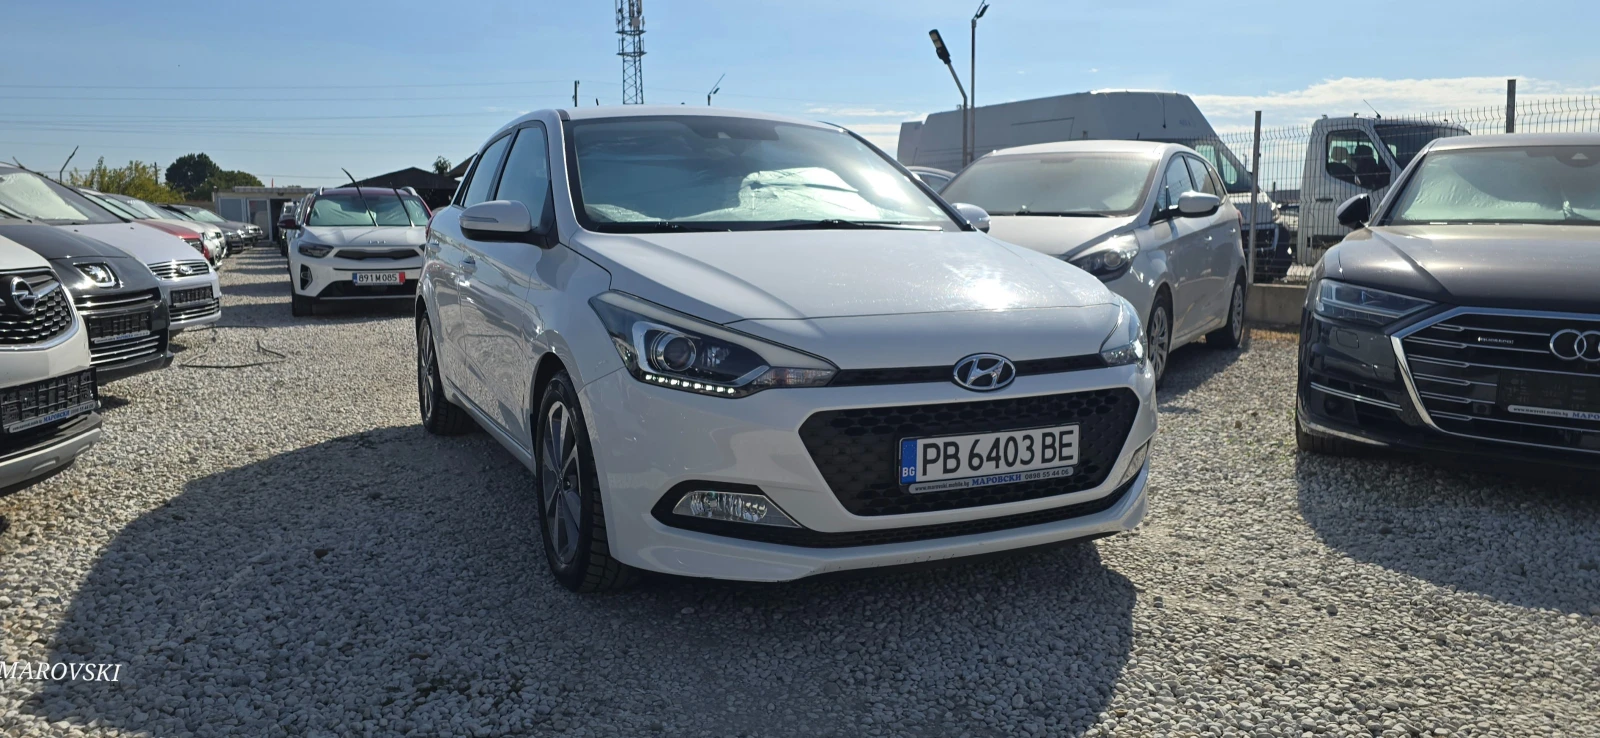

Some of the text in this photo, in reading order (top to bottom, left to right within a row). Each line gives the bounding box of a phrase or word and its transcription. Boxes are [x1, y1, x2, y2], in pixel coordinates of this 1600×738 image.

[359, 273, 373, 282] 891
[382, 273, 397, 282] 085
[902, 430, 1074, 477] BG PB 6403 BE
[971, 474, 1022, 486] МАРОВСКИ
[1024, 472, 1041, 480] 0898
[1042, 470, 1050, 478] 55
